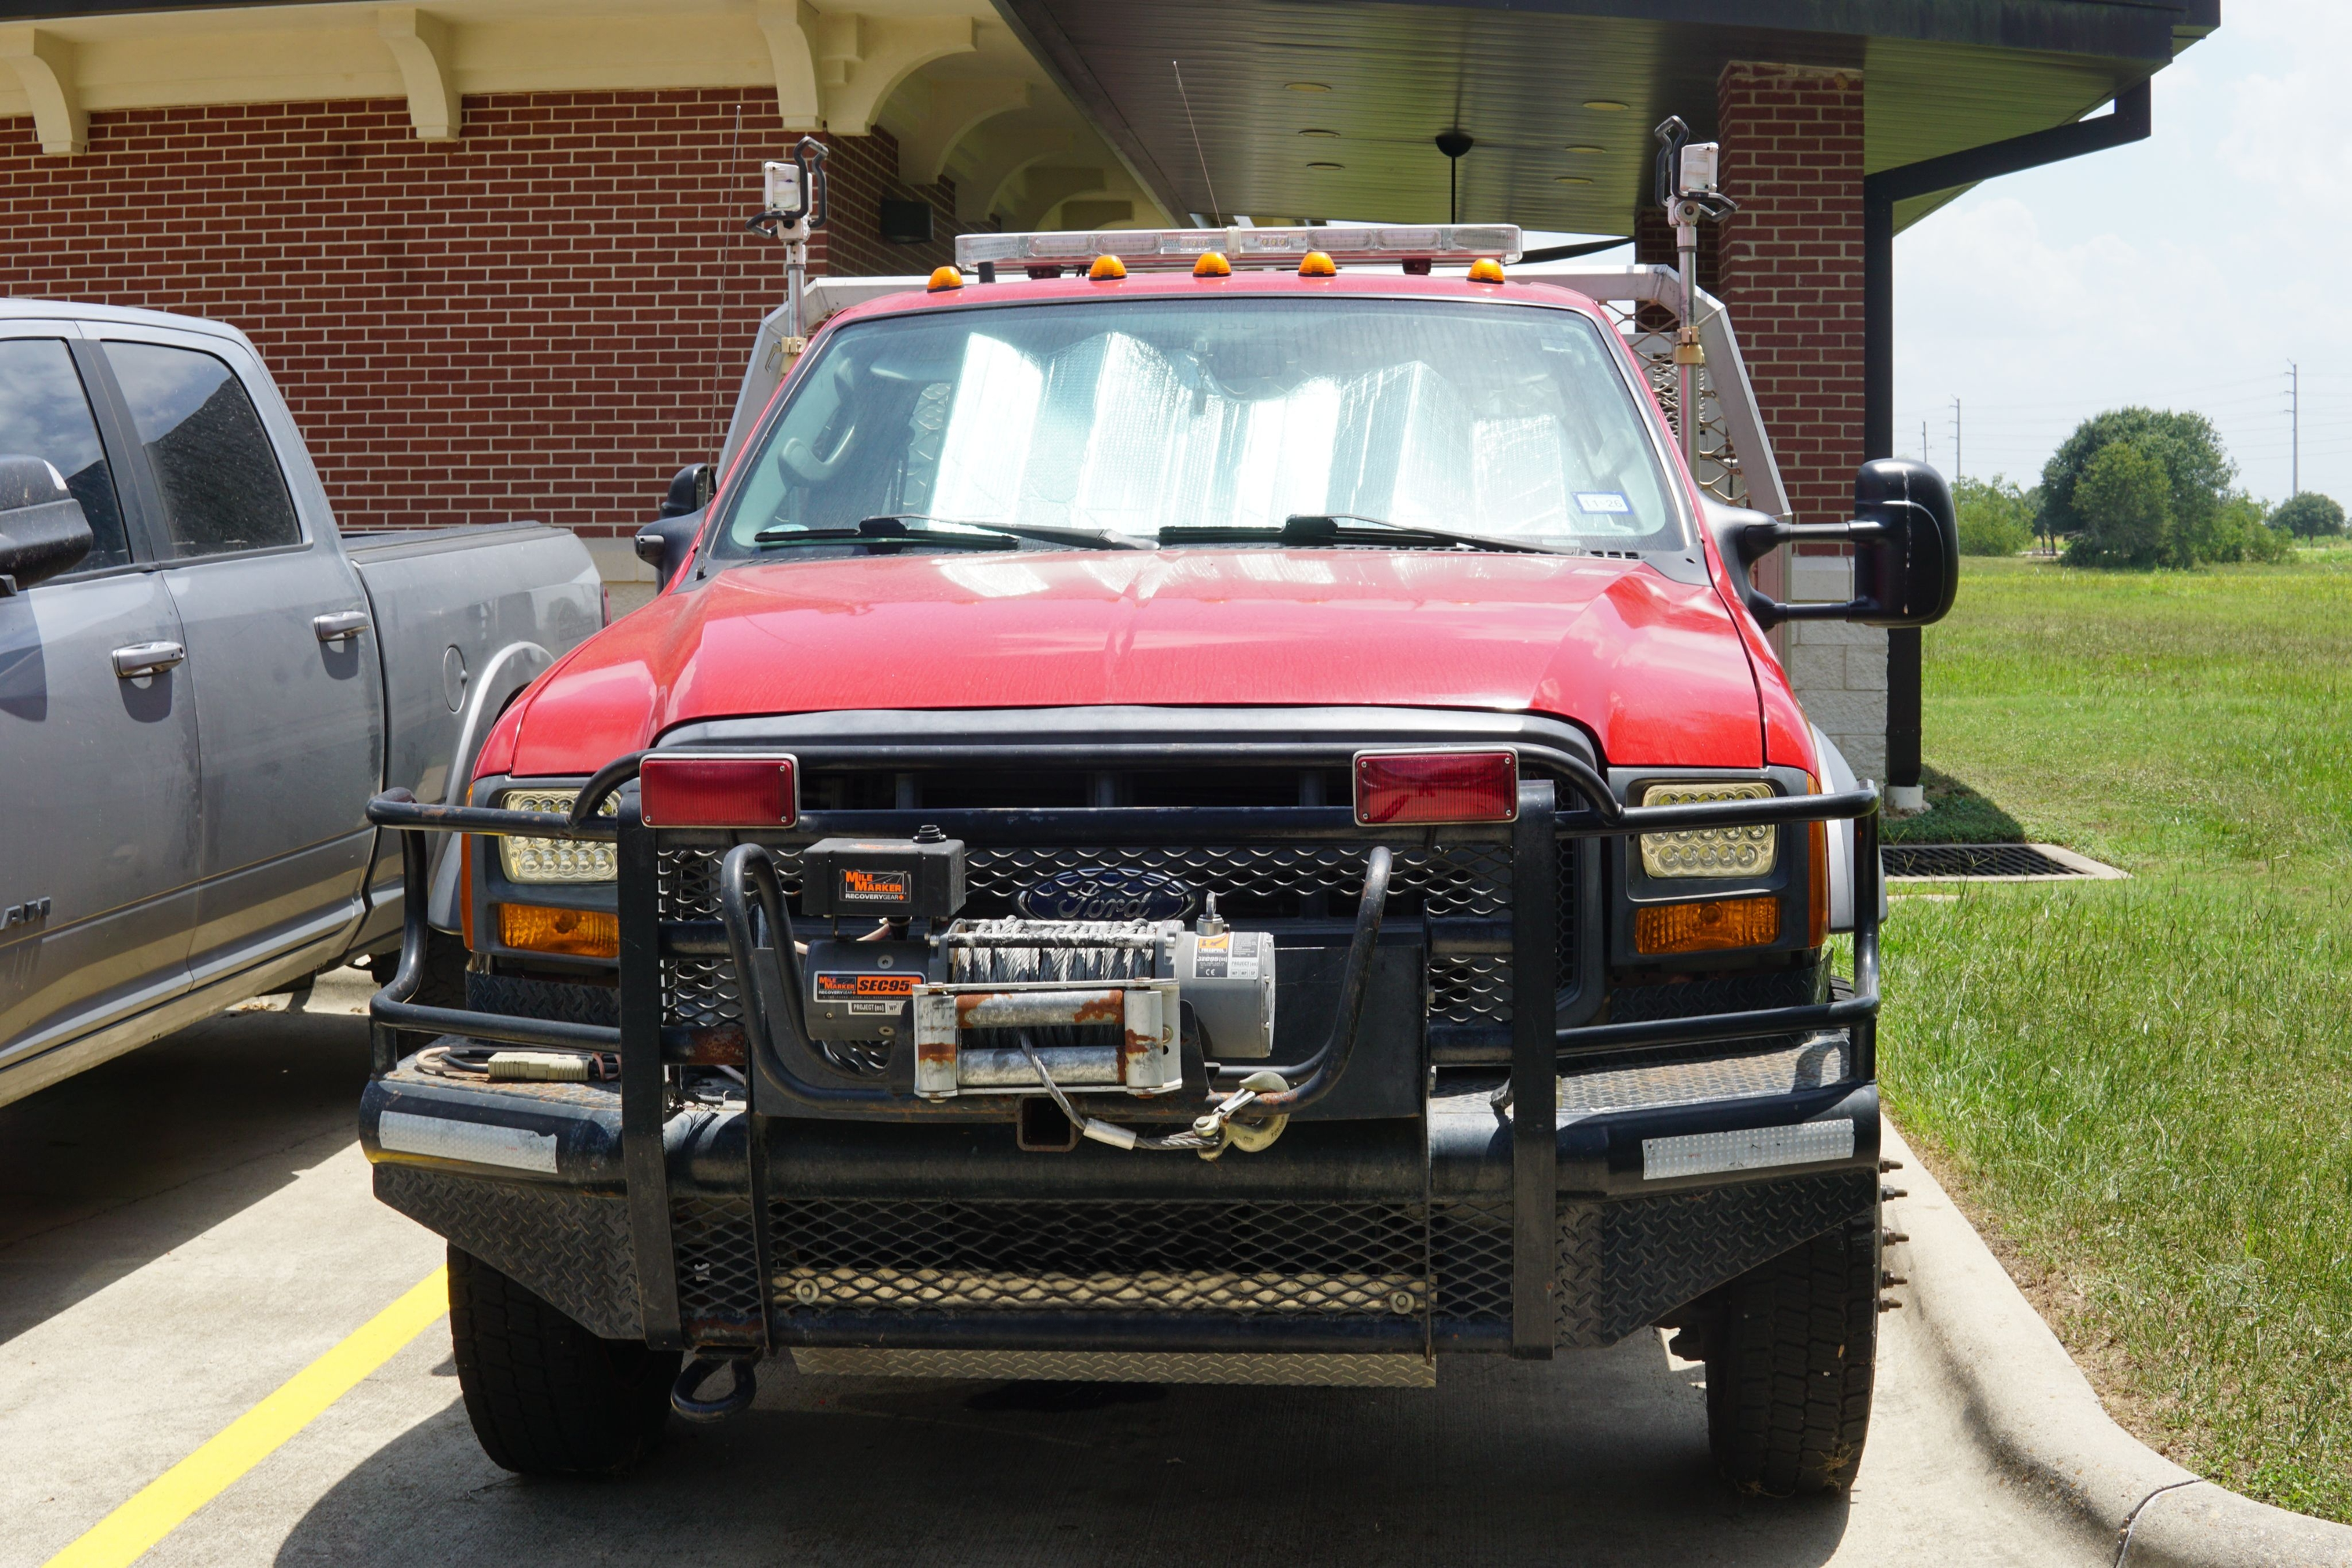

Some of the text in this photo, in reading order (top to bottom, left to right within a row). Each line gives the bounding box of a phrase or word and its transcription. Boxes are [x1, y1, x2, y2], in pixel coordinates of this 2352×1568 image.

[1605, 499, 1623, 508] 26
[846, 871, 873, 883] MILE
[855, 880, 902, 892] MARKER
[1058, 880, 1152, 920] Ford
[0, 896, 51, 931] AM
